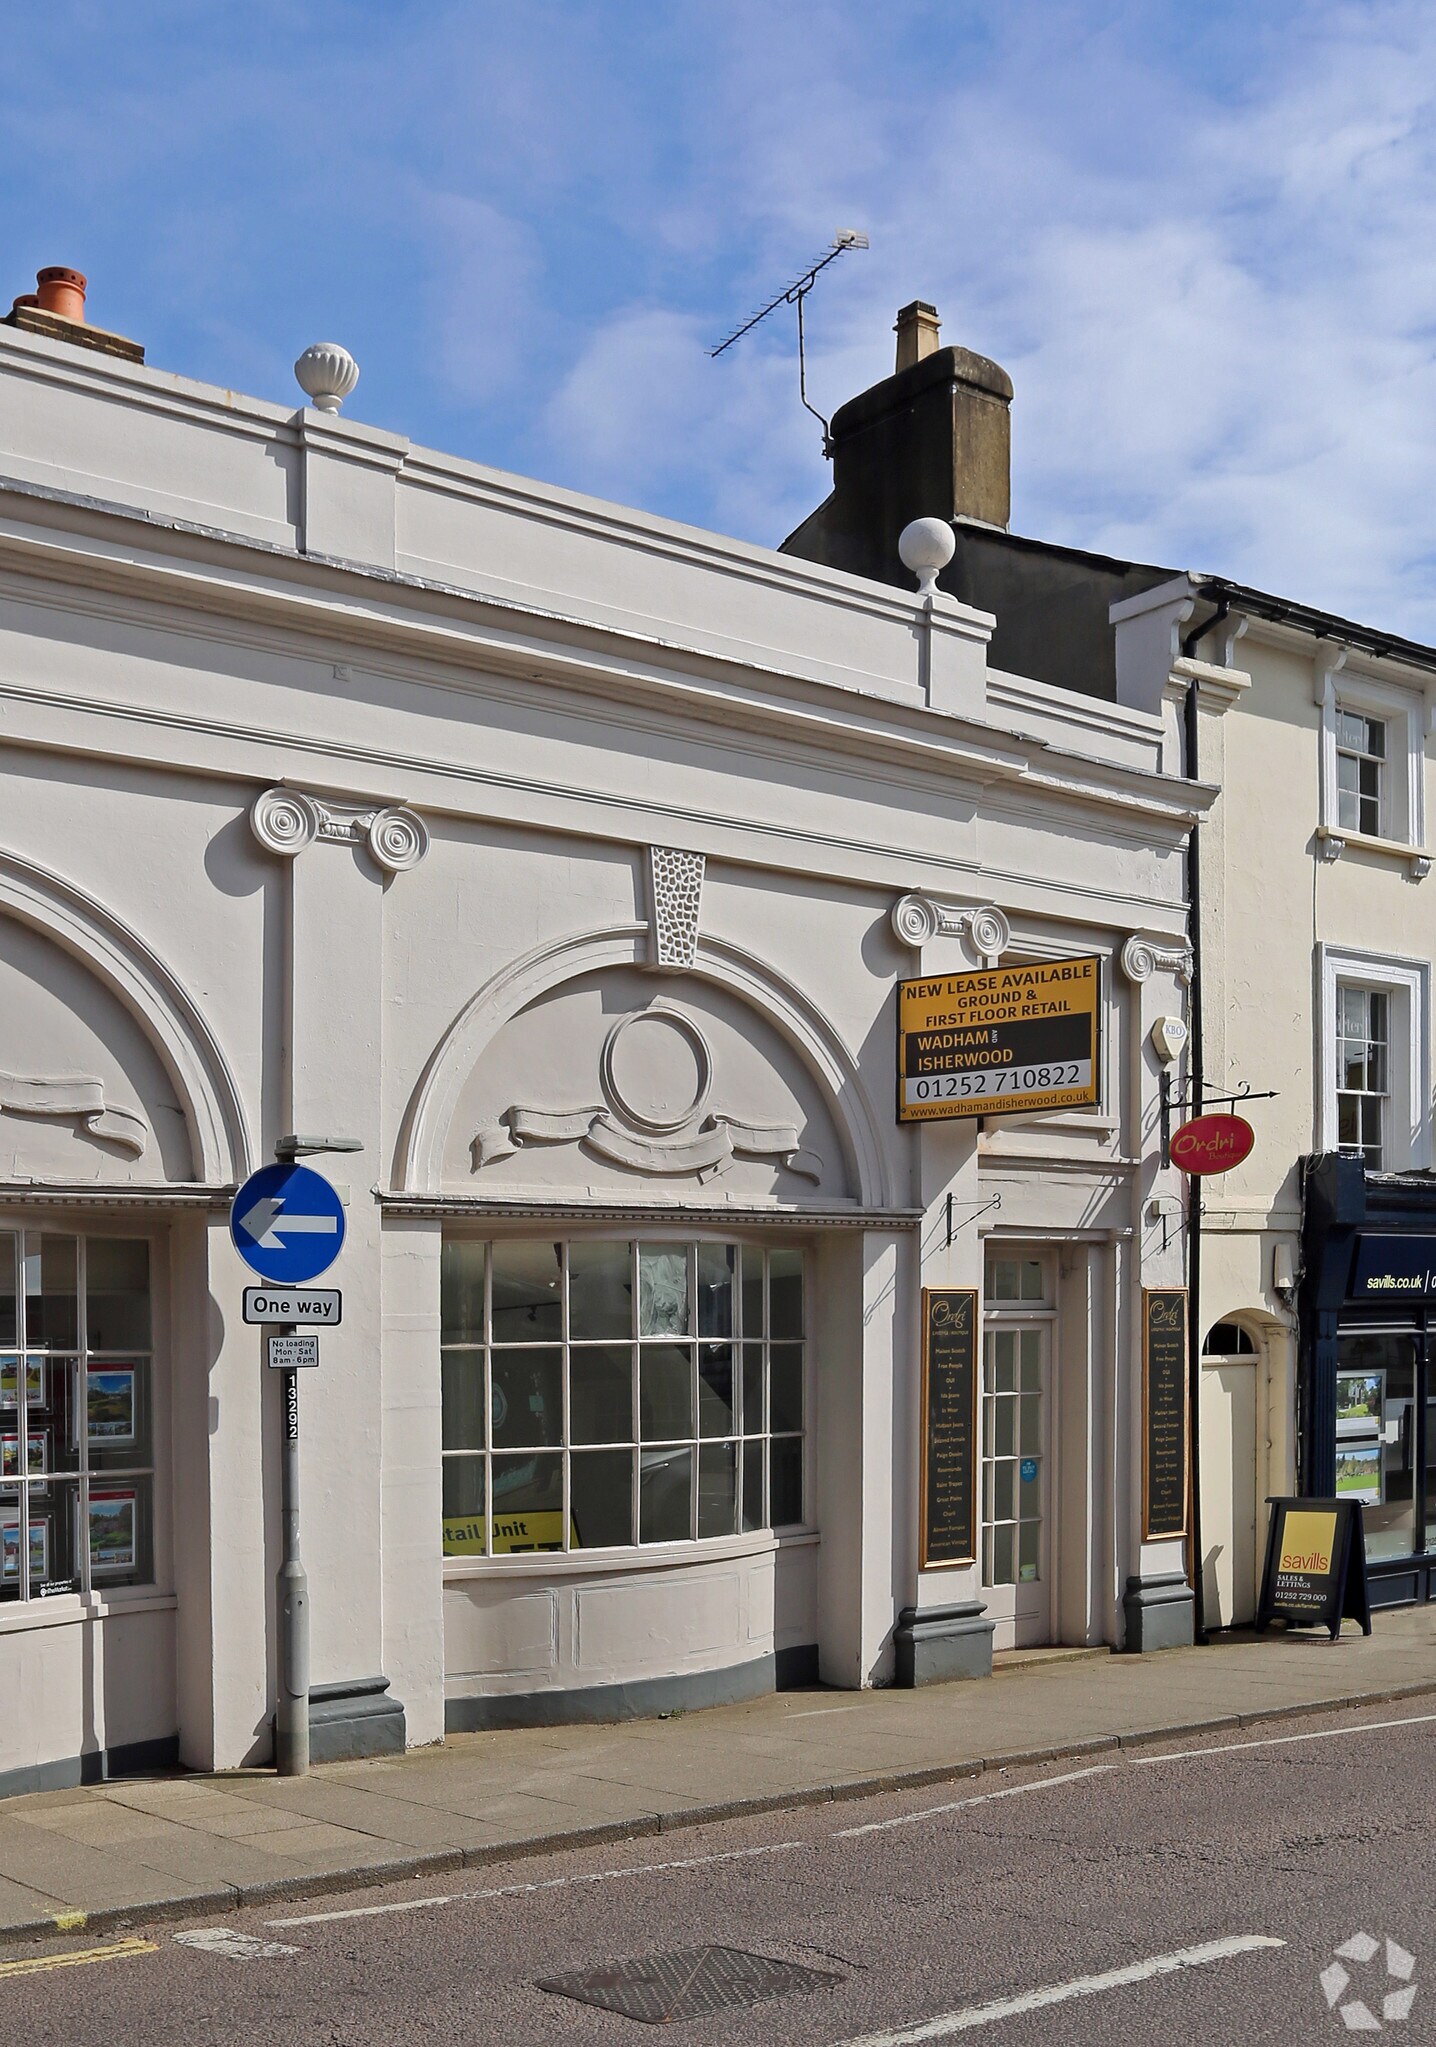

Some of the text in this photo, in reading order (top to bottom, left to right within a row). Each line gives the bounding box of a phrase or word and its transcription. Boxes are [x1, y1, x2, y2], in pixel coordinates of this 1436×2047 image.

[906, 964, 1092, 1000] NEW LEASE AVAILABLE
[958, 989, 1038, 1008] GROUND &
[926, 1000, 1071, 1028] FIRST FLOOR RETAIL
[918, 1030, 989, 1050] WADHAM
[1166, 1024, 1182, 1036] KBO
[918, 1048, 1013, 1072] ISHERWOOD
[916, 1064, 1080, 1098] 01252 710822
[910, 1091, 1089, 1118] www.wadhamandisherwood.co.uk
[1174, 1131, 1234, 1154] Ordri
[1366, 1274, 1422, 1288] savills.co.uk
[254, 1296, 332, 1317] One way
[288, 1374, 298, 1438] 13292
[442, 1524, 482, 1542] tail
[1282, 1552, 1328, 1571] savills
[1275, 1592, 1328, 1602] 01252 729 000
